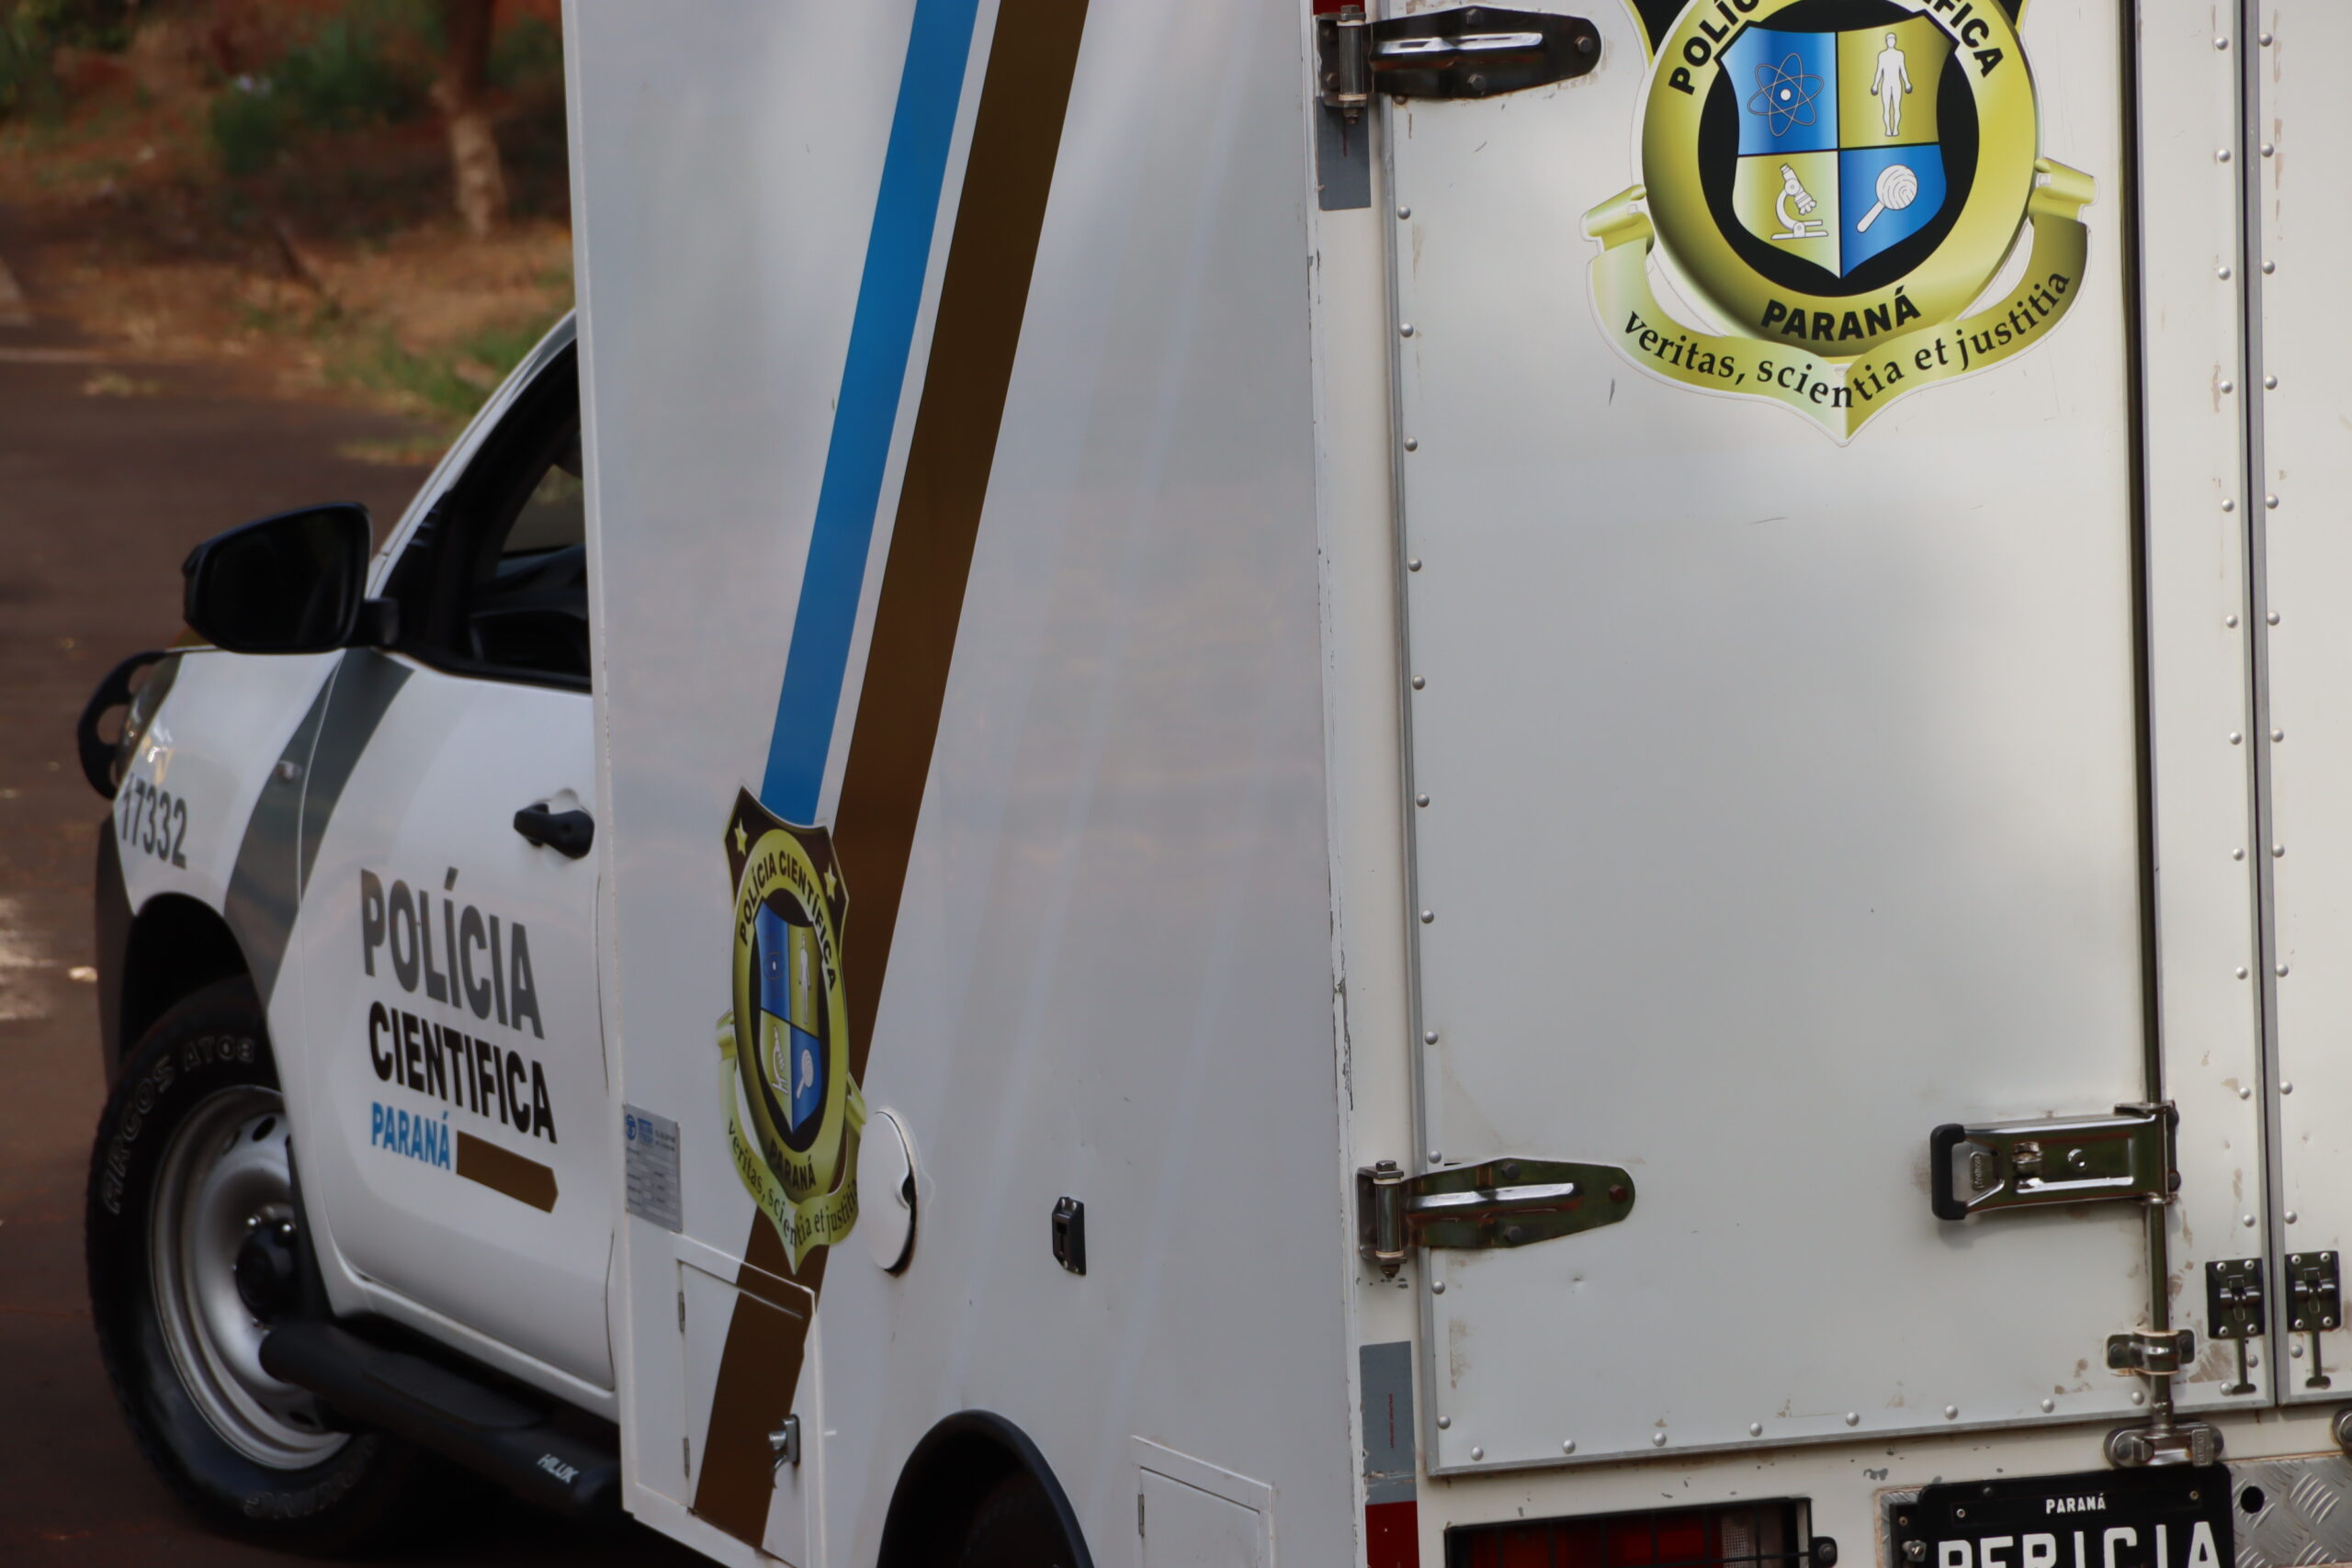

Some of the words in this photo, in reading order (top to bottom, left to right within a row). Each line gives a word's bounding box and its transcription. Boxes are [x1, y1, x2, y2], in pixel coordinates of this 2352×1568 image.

[1622, 311, 1746, 386] veritas,
[1756, 356, 1905, 408] scientia
[1914, 336, 1949, 371] et
[1955, 269, 2071, 371] justitia
[1760, 285, 1921, 342] PARANÁ
[122, 774, 187, 871] 17332
[361, 866, 546, 1040] POLÍCIA
[739, 852, 777, 947] POLÍCIA
[778, 850, 837, 992] CIENTÍFICA
[369, 1001, 559, 1145] CIENTIFICA
[371, 1101, 452, 1171] PARANÁ
[768, 1137, 817, 1191] PARANÁ
[814, 1211, 825, 1234] et
[2045, 1493, 2107, 1515] PARANÁ
